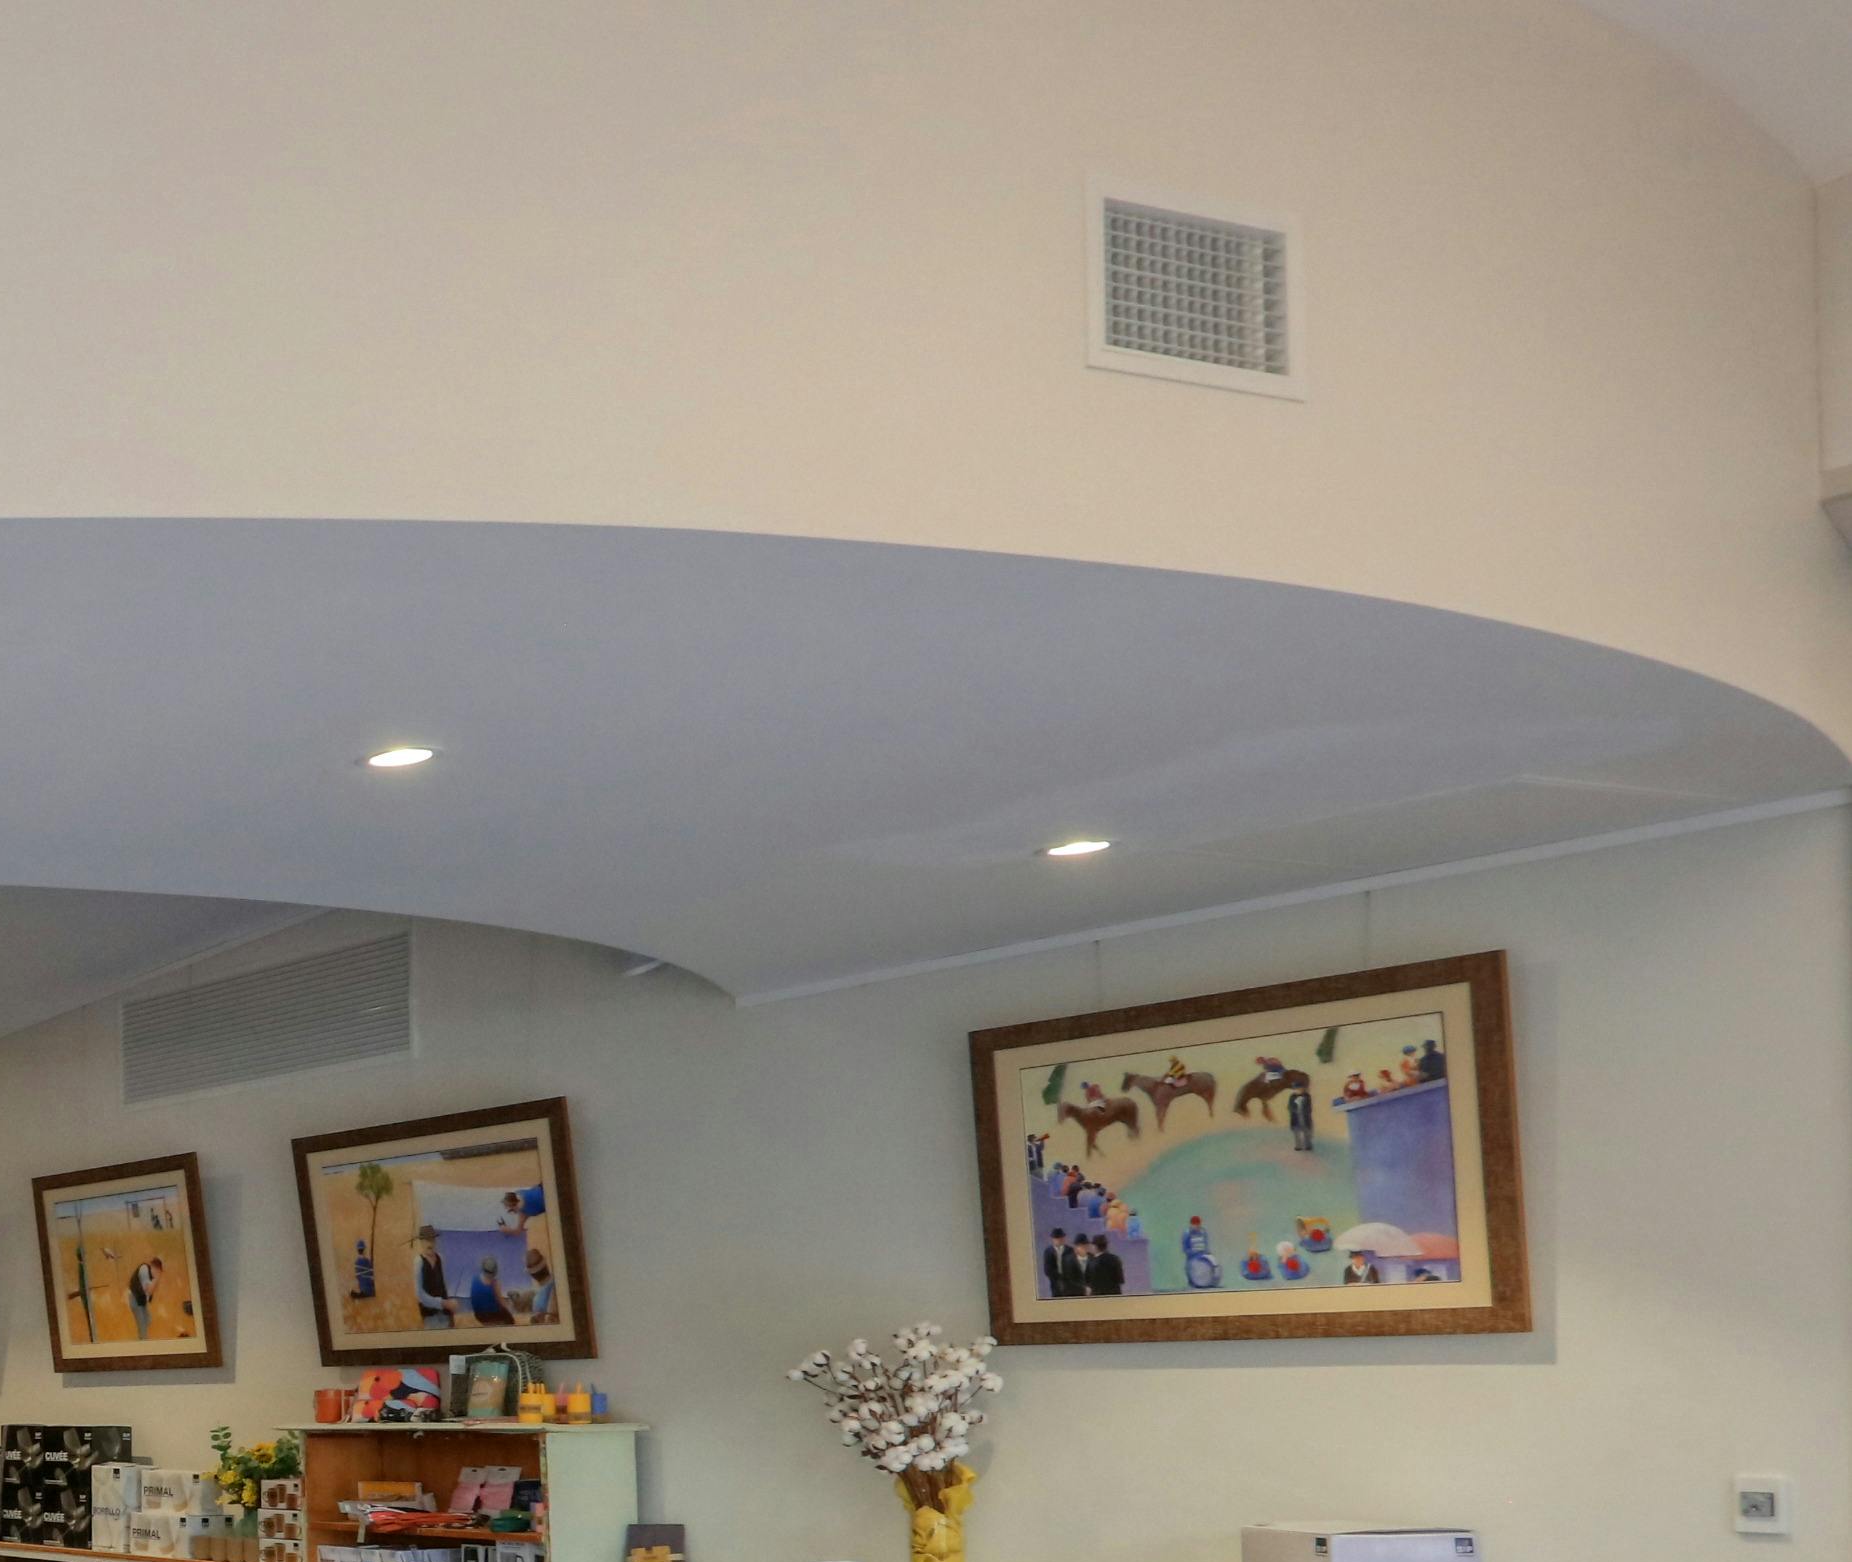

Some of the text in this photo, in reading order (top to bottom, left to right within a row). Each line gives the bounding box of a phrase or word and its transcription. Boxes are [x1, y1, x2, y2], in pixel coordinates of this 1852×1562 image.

[5, 1449, 21, 1460] UVÉE
[143, 1486, 173, 1497] PRIMAL
[132, 1528, 160, 1538] PRIMAL
